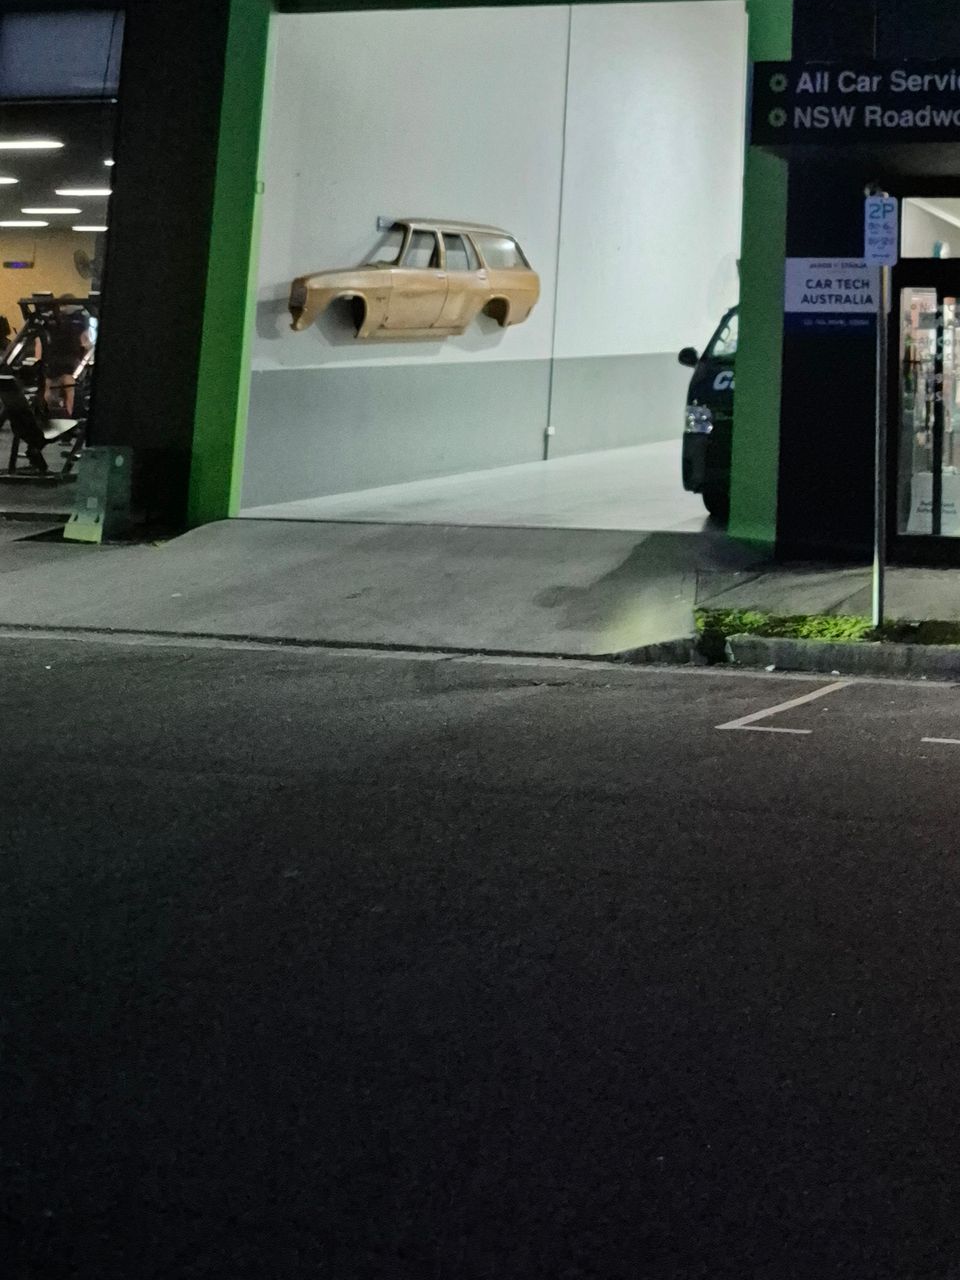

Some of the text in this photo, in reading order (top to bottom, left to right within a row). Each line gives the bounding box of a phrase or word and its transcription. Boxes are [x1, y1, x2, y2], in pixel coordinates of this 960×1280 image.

[796, 71, 828, 93] All
[838, 71, 880, 93] Car
[793, 106, 856, 128] NSW
[869, 203, 894, 219] 2P
[806, 279, 870, 289] CAR TECH
[801, 294, 873, 304] AUSTRALIA
